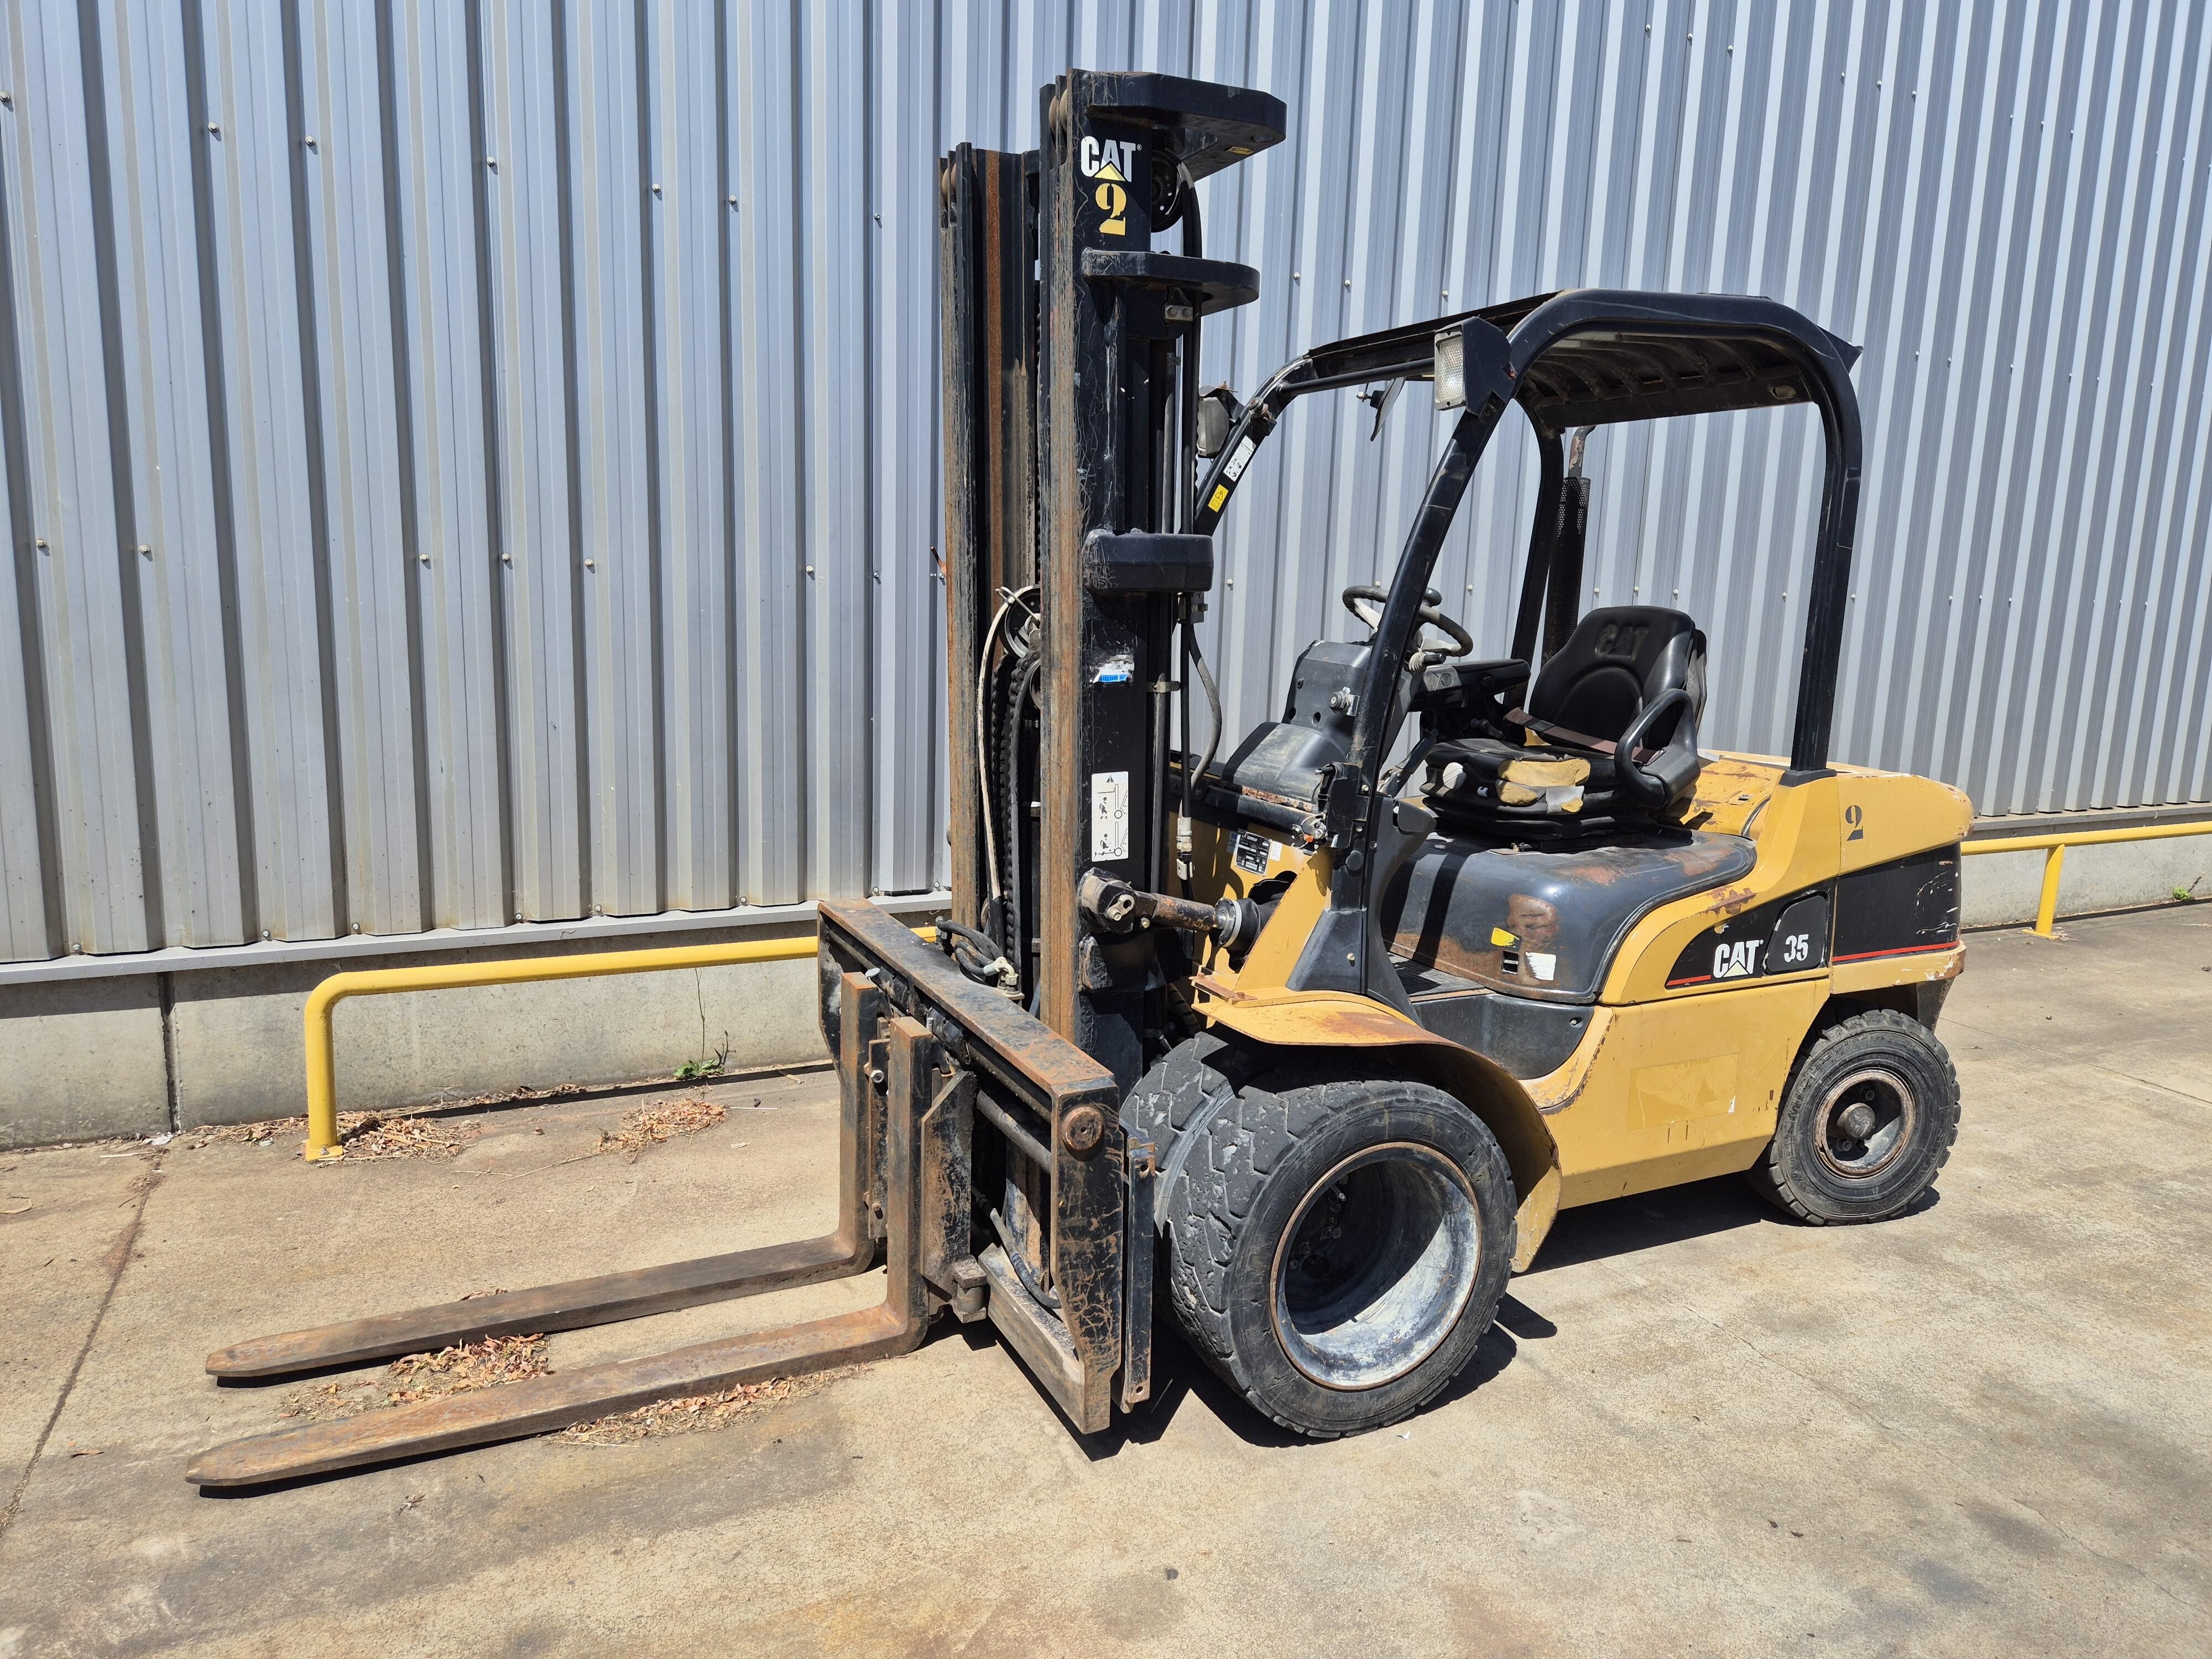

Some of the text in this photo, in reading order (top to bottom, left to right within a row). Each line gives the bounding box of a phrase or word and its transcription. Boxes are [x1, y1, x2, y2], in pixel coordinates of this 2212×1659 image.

[1095, 183, 1126, 236] 2
[1845, 805, 1864, 841] 2
[1713, 934, 1809, 978] CAT 35
